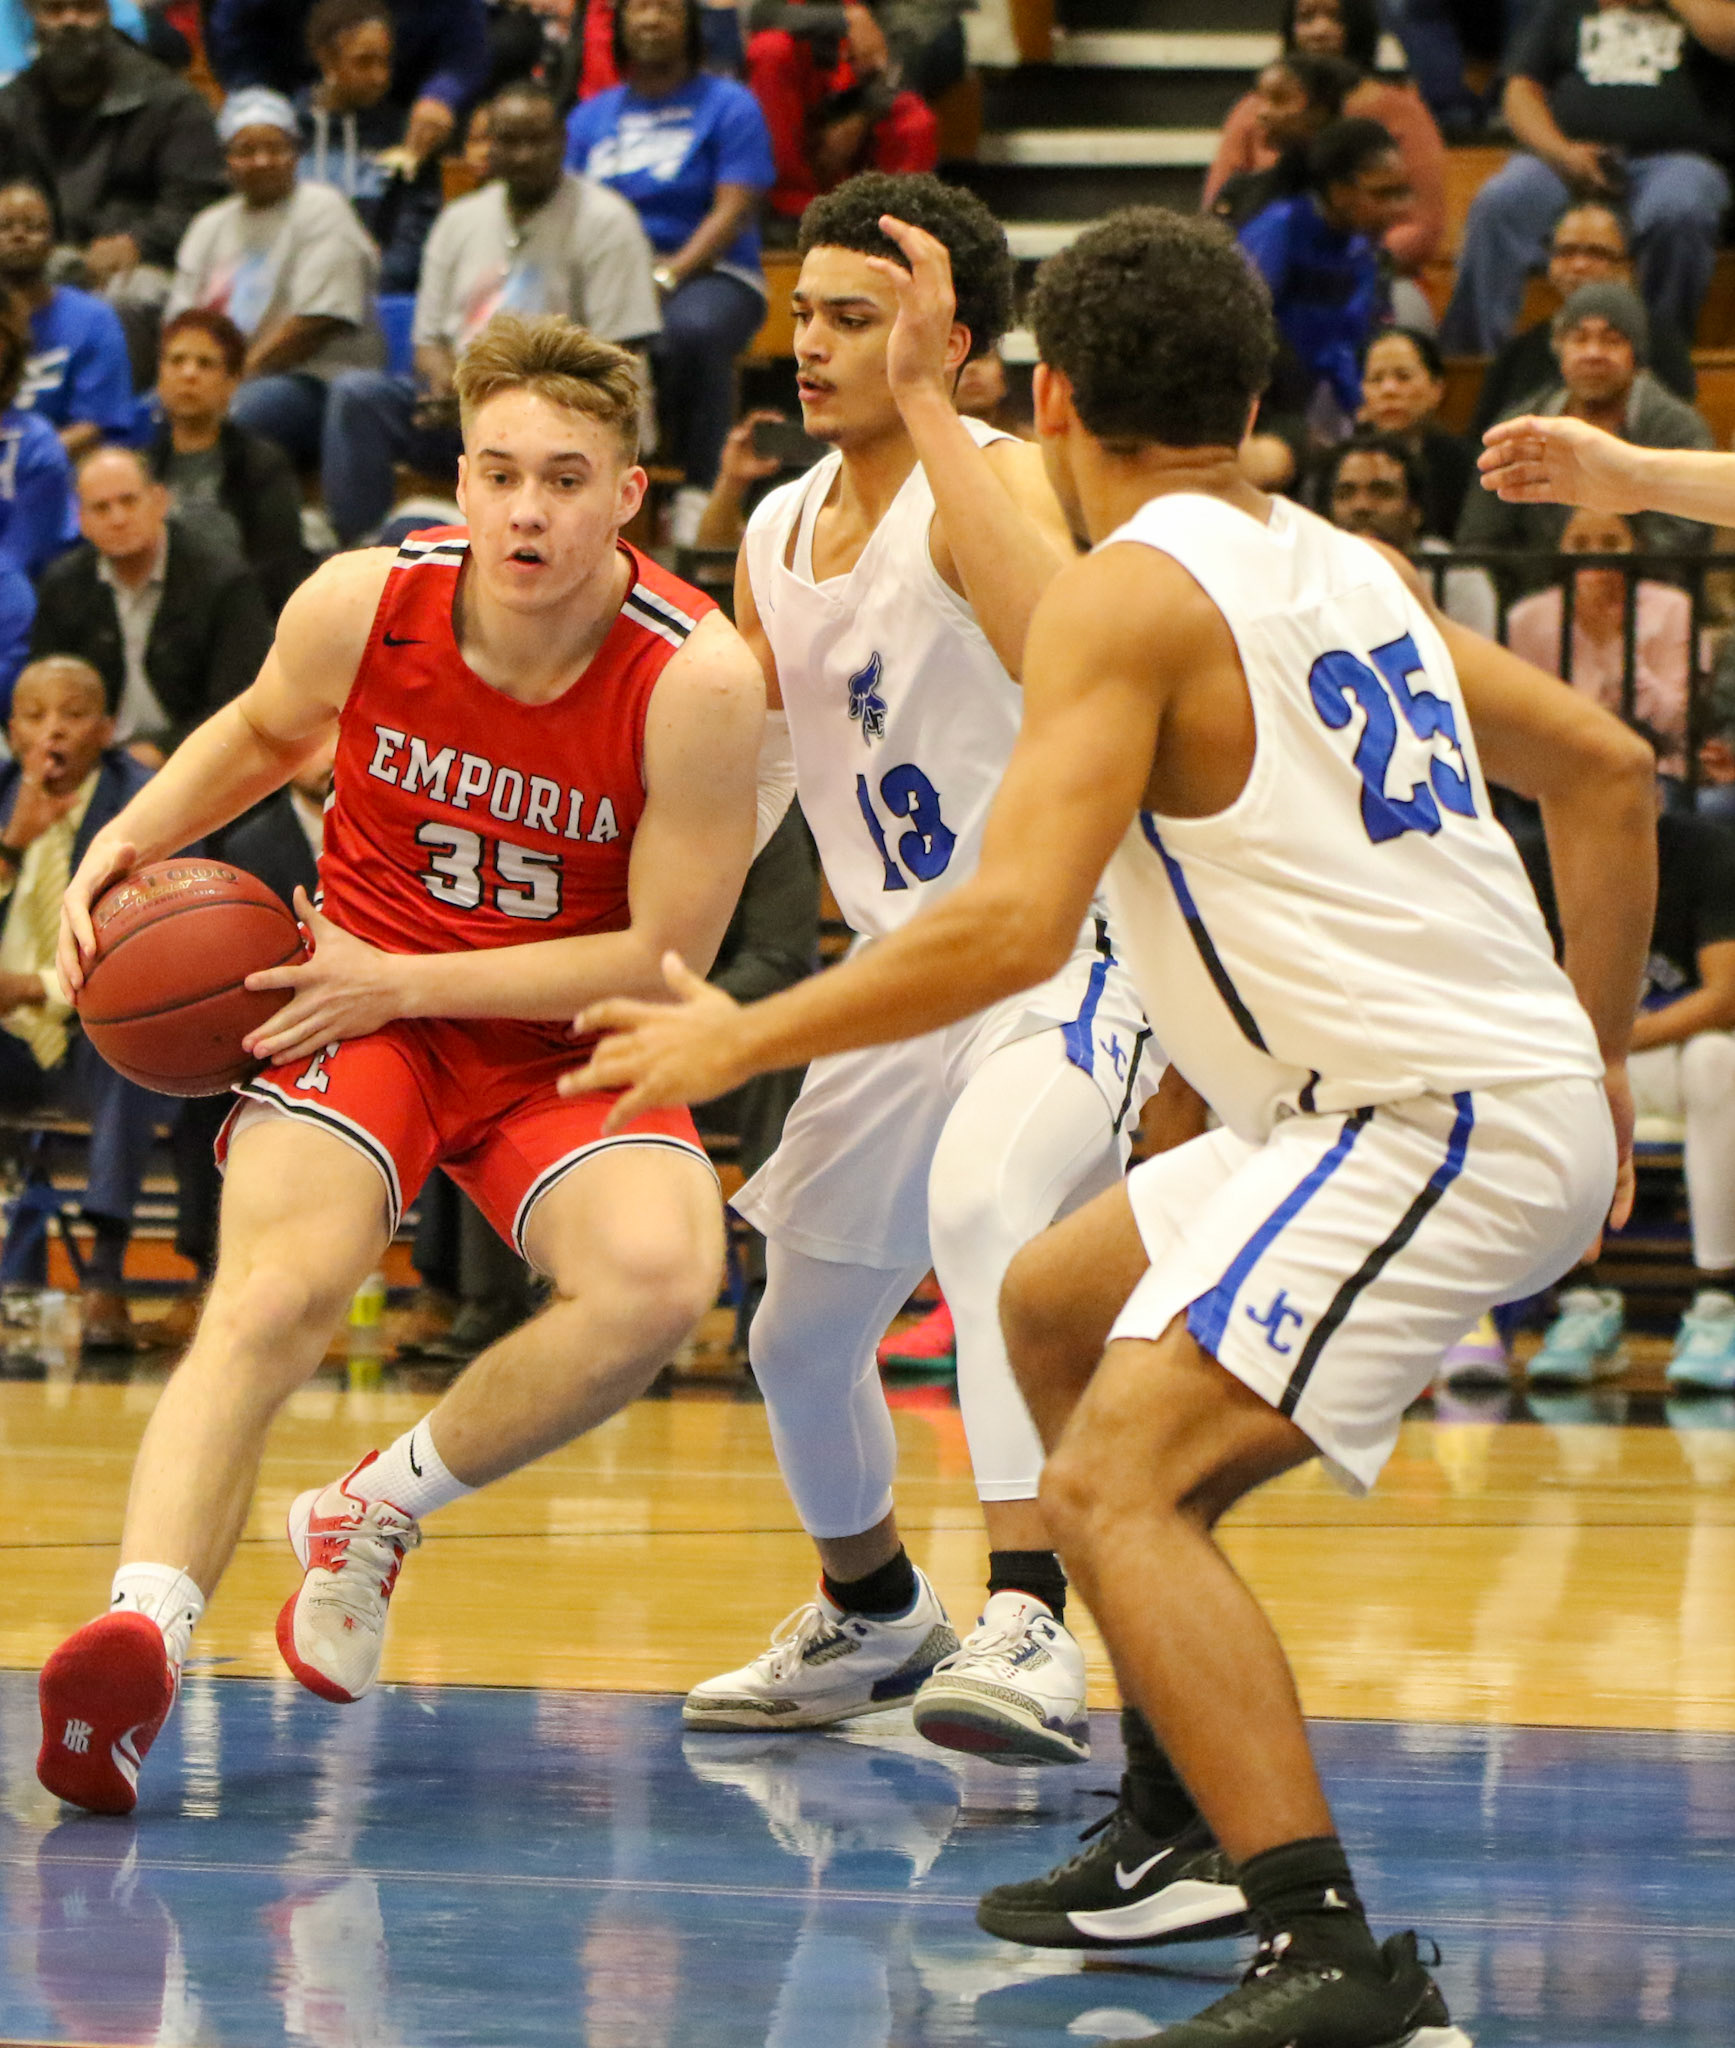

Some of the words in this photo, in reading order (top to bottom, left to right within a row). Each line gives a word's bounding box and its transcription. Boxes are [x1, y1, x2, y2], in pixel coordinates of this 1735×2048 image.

[367, 724, 620, 843] EMPORIA
[1307, 631, 1478, 844] 25
[414, 819, 564, 921] 35
[856, 763, 958, 891] 13
[1246, 1288, 1303, 1354] JC
